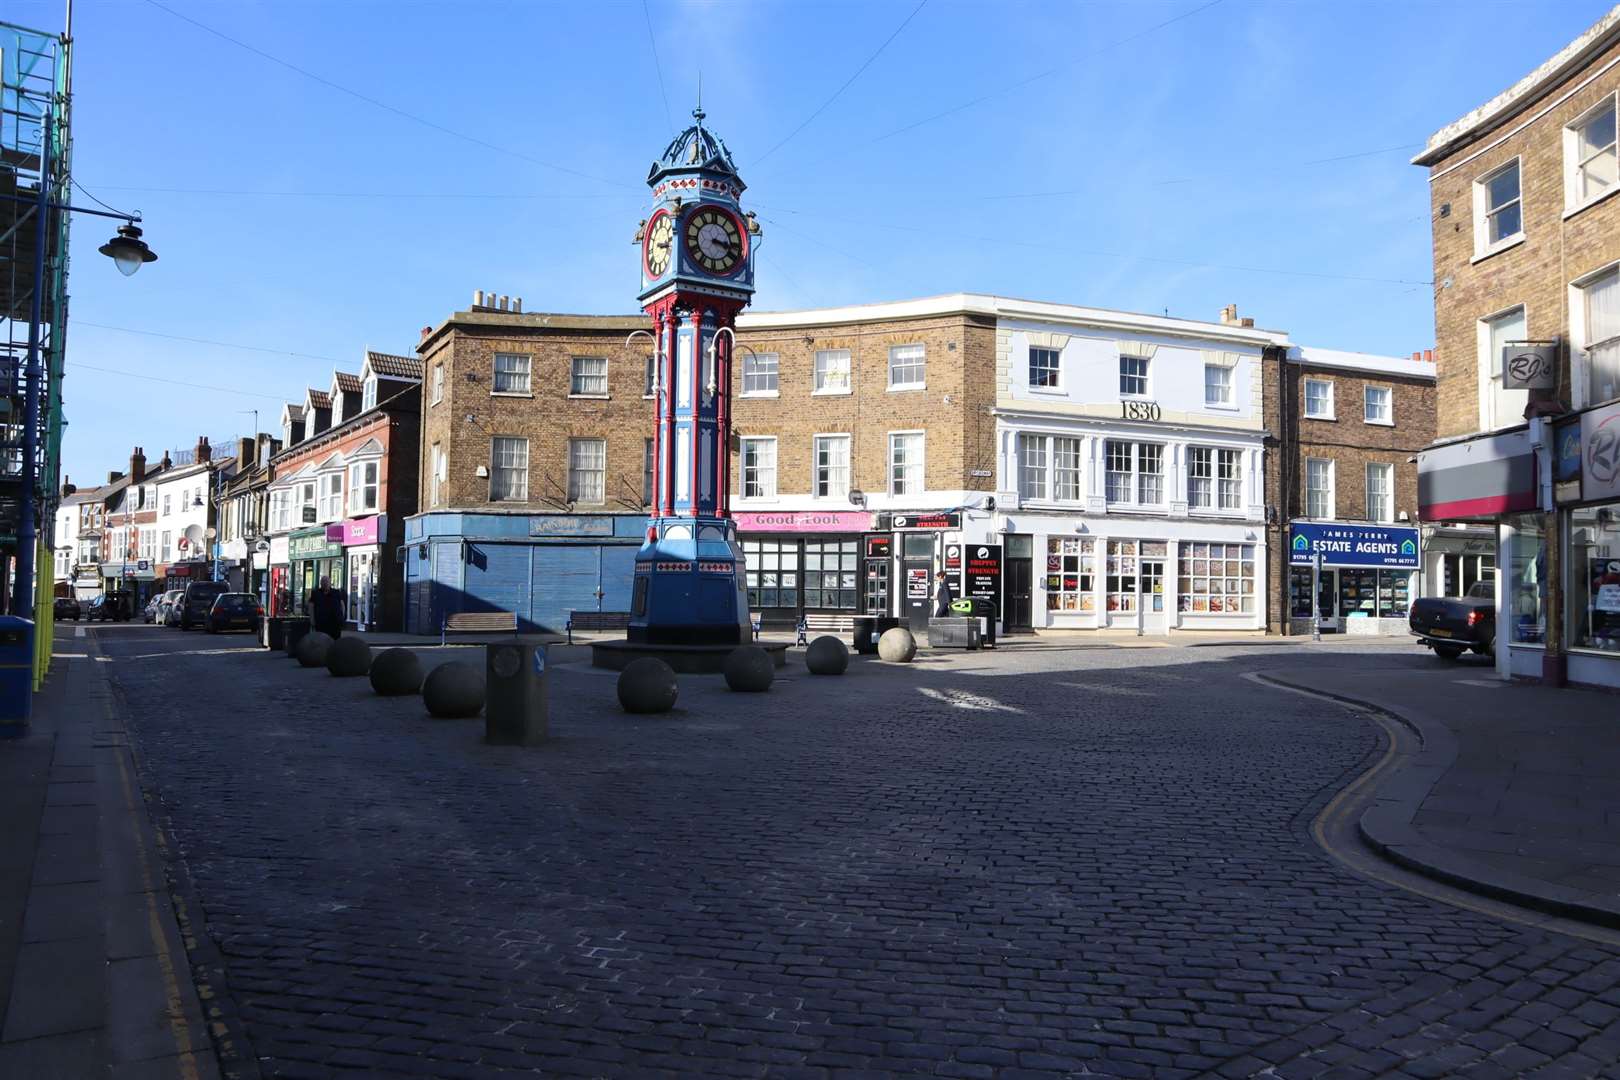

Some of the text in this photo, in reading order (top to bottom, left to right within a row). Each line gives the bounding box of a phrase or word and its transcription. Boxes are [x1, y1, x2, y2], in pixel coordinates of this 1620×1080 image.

[1121, 401, 1161, 421] 1830
[756, 514, 795, 525] Good
[1323, 530, 1388, 540] JAMES PERRY
[1313, 540, 1398, 554] ESTATE AGENTS
